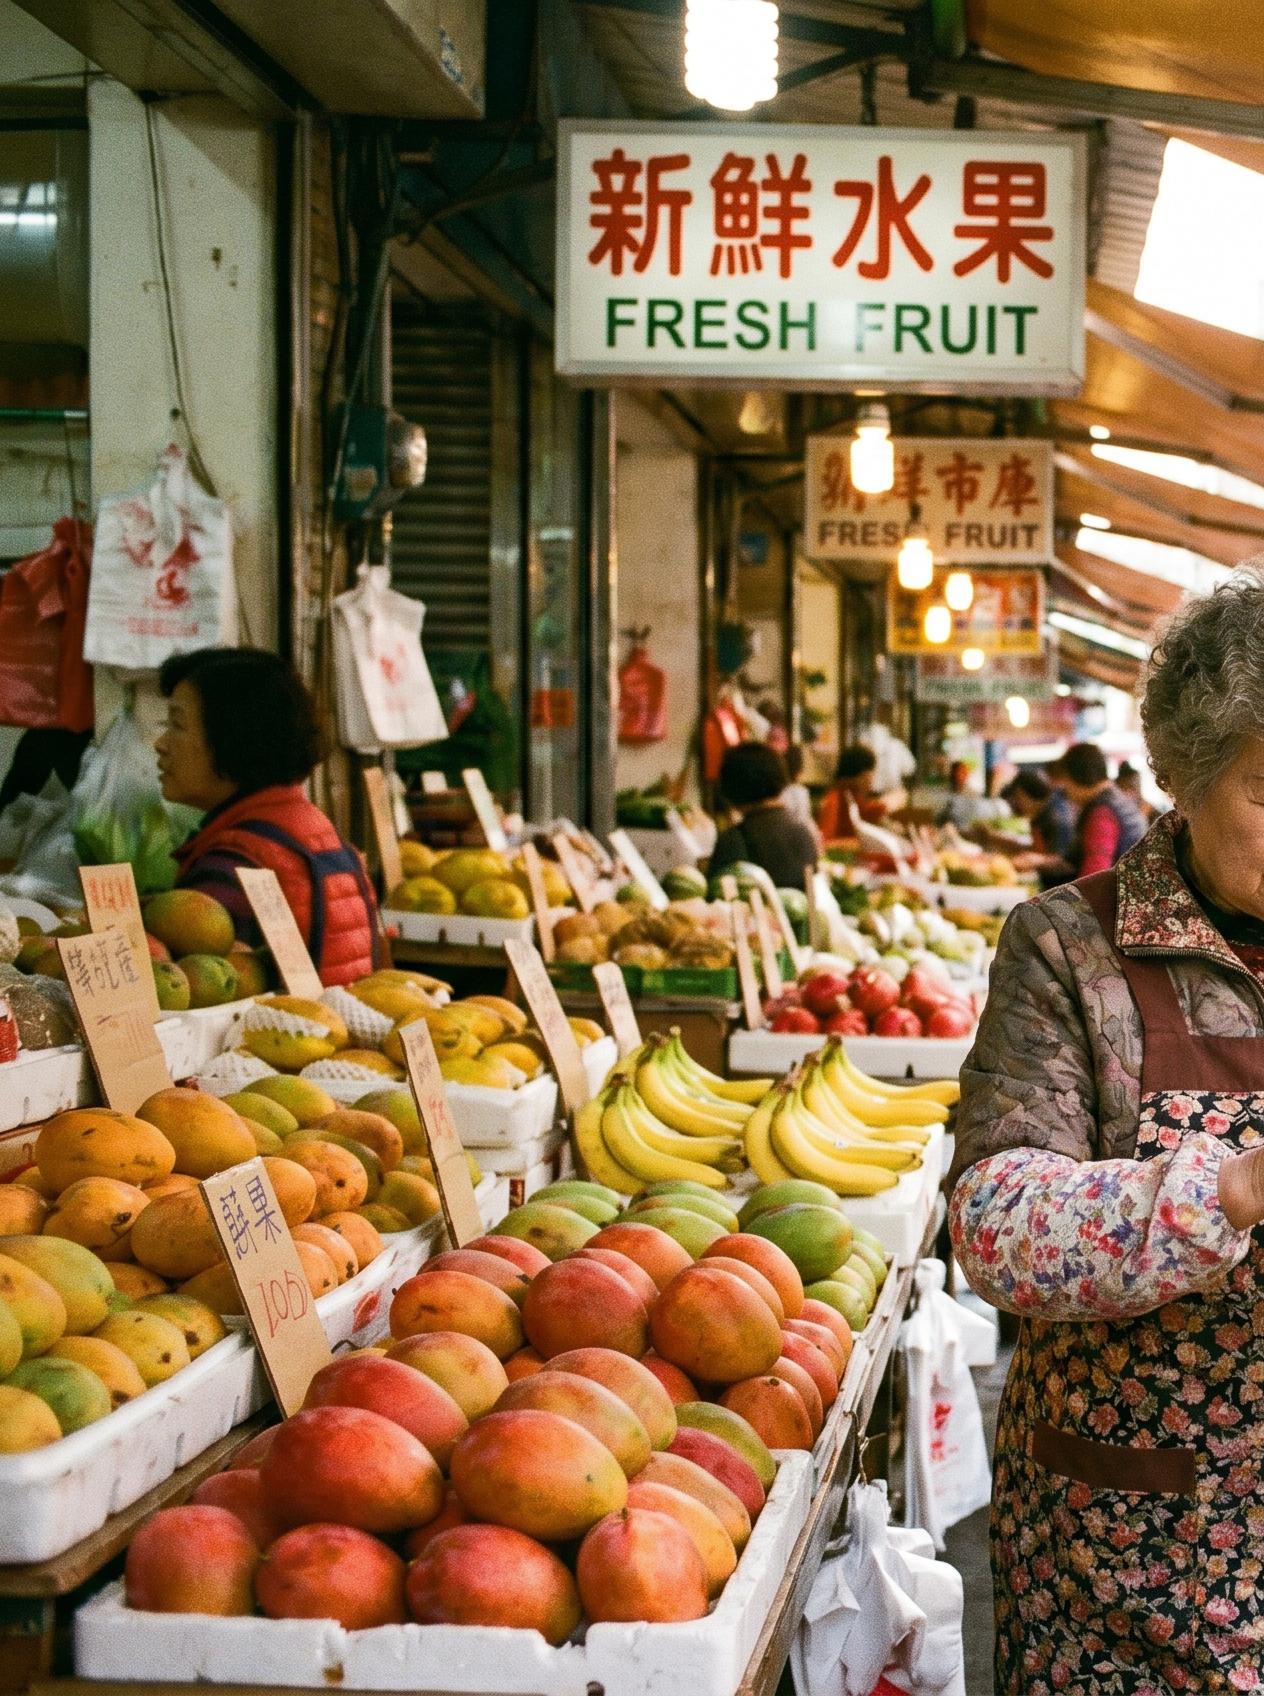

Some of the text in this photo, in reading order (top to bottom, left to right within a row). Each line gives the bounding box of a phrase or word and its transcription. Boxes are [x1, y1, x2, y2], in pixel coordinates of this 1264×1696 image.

[588, 148, 1055, 284] 新鮮水果
[606, 298, 1038, 355] FRESH FRUIT
[818, 519, 1040, 549] FRES FRUIT
